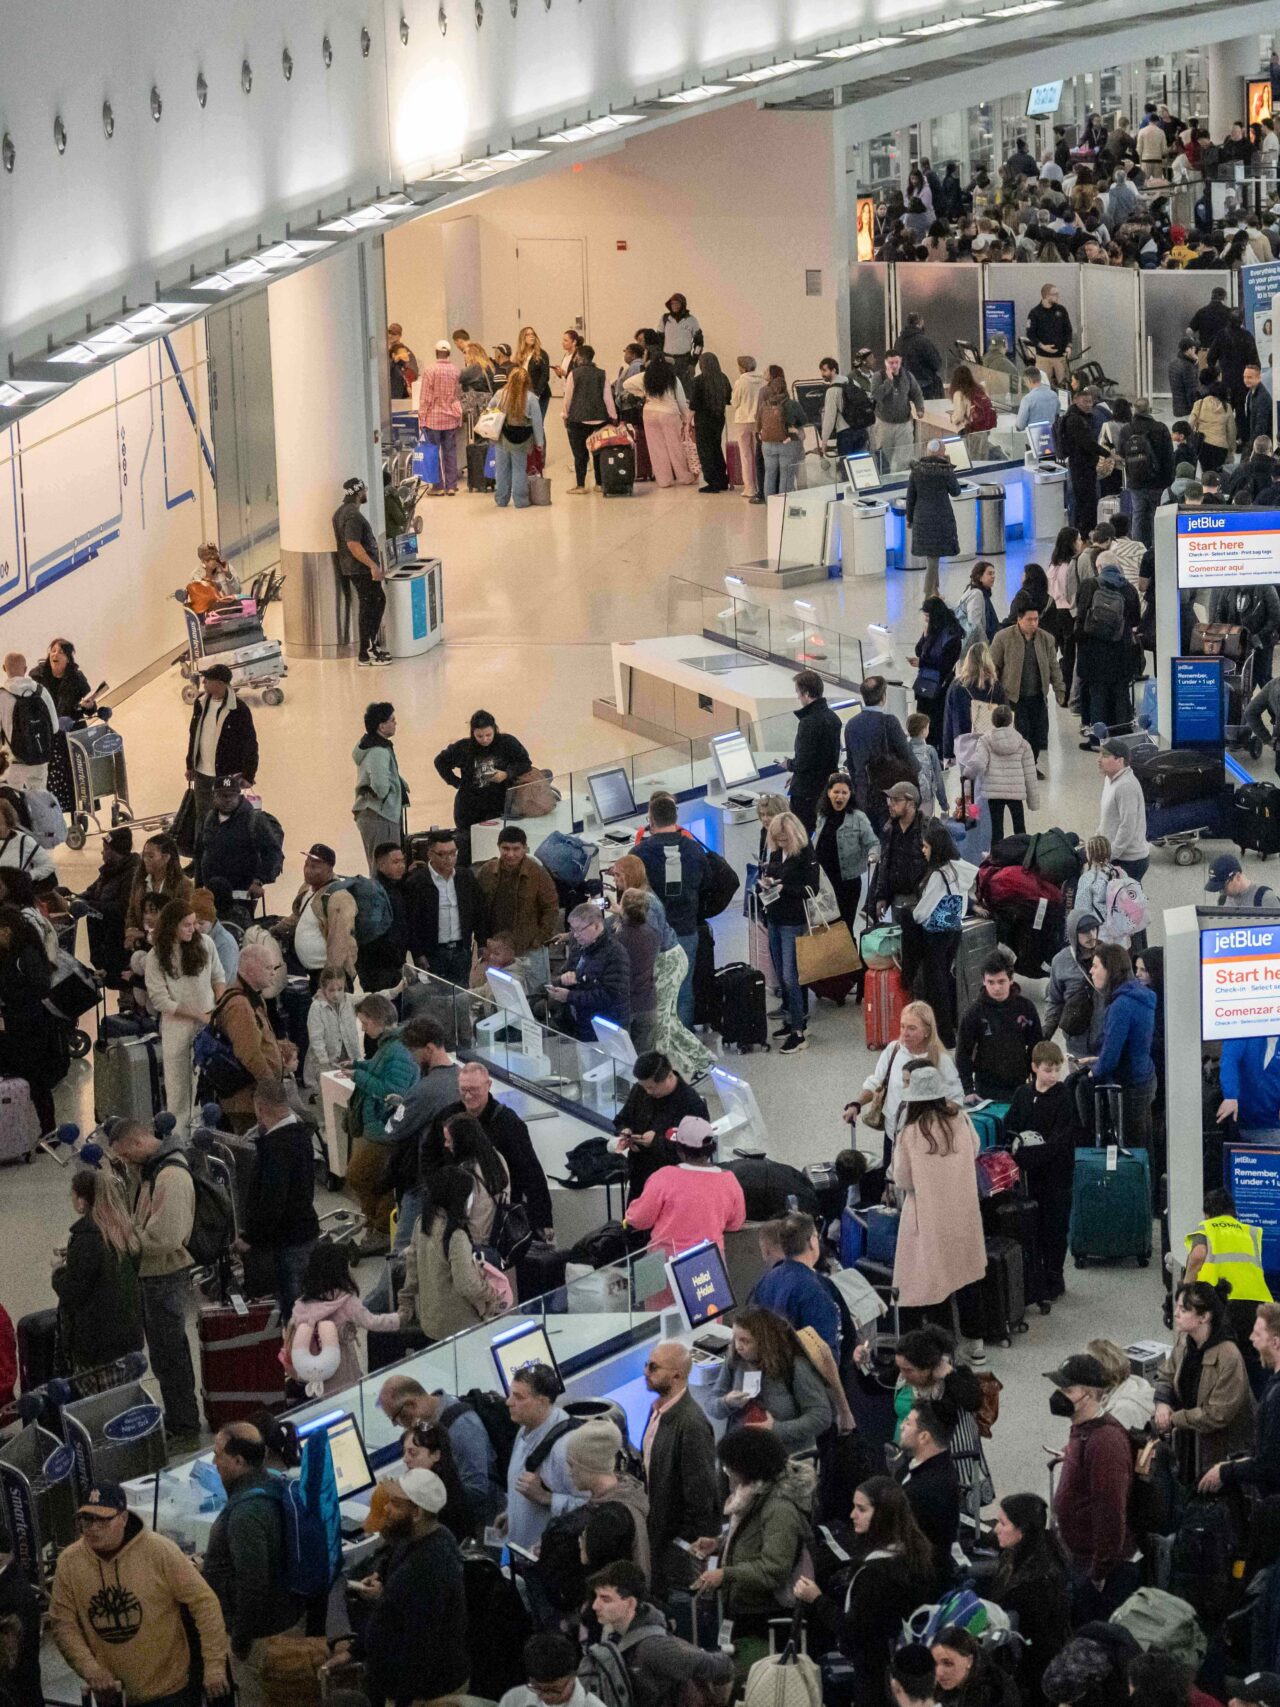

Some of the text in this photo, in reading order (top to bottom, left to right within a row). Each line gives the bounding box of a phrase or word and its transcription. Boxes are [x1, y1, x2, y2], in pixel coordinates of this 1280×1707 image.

[1187, 516, 1226, 532] jetBlue
[1189, 540, 1244, 551] Start here
[1188, 564, 1227, 573] Comenzar
[1214, 929, 1273, 953] jetBlue
[1216, 968, 1259, 984] Start
[1215, 985, 1246, 994] Check-in
[1251, 984, 1272, 992] Select
[1215, 1006, 1274, 1018] Comenzar
[1234, 1156, 1257, 1164] jetBlue
[1234, 1168, 1279, 1179] Remember,
[1240, 1178, 1263, 1186] under
[691, 1270, 712, 1287] Hello!
